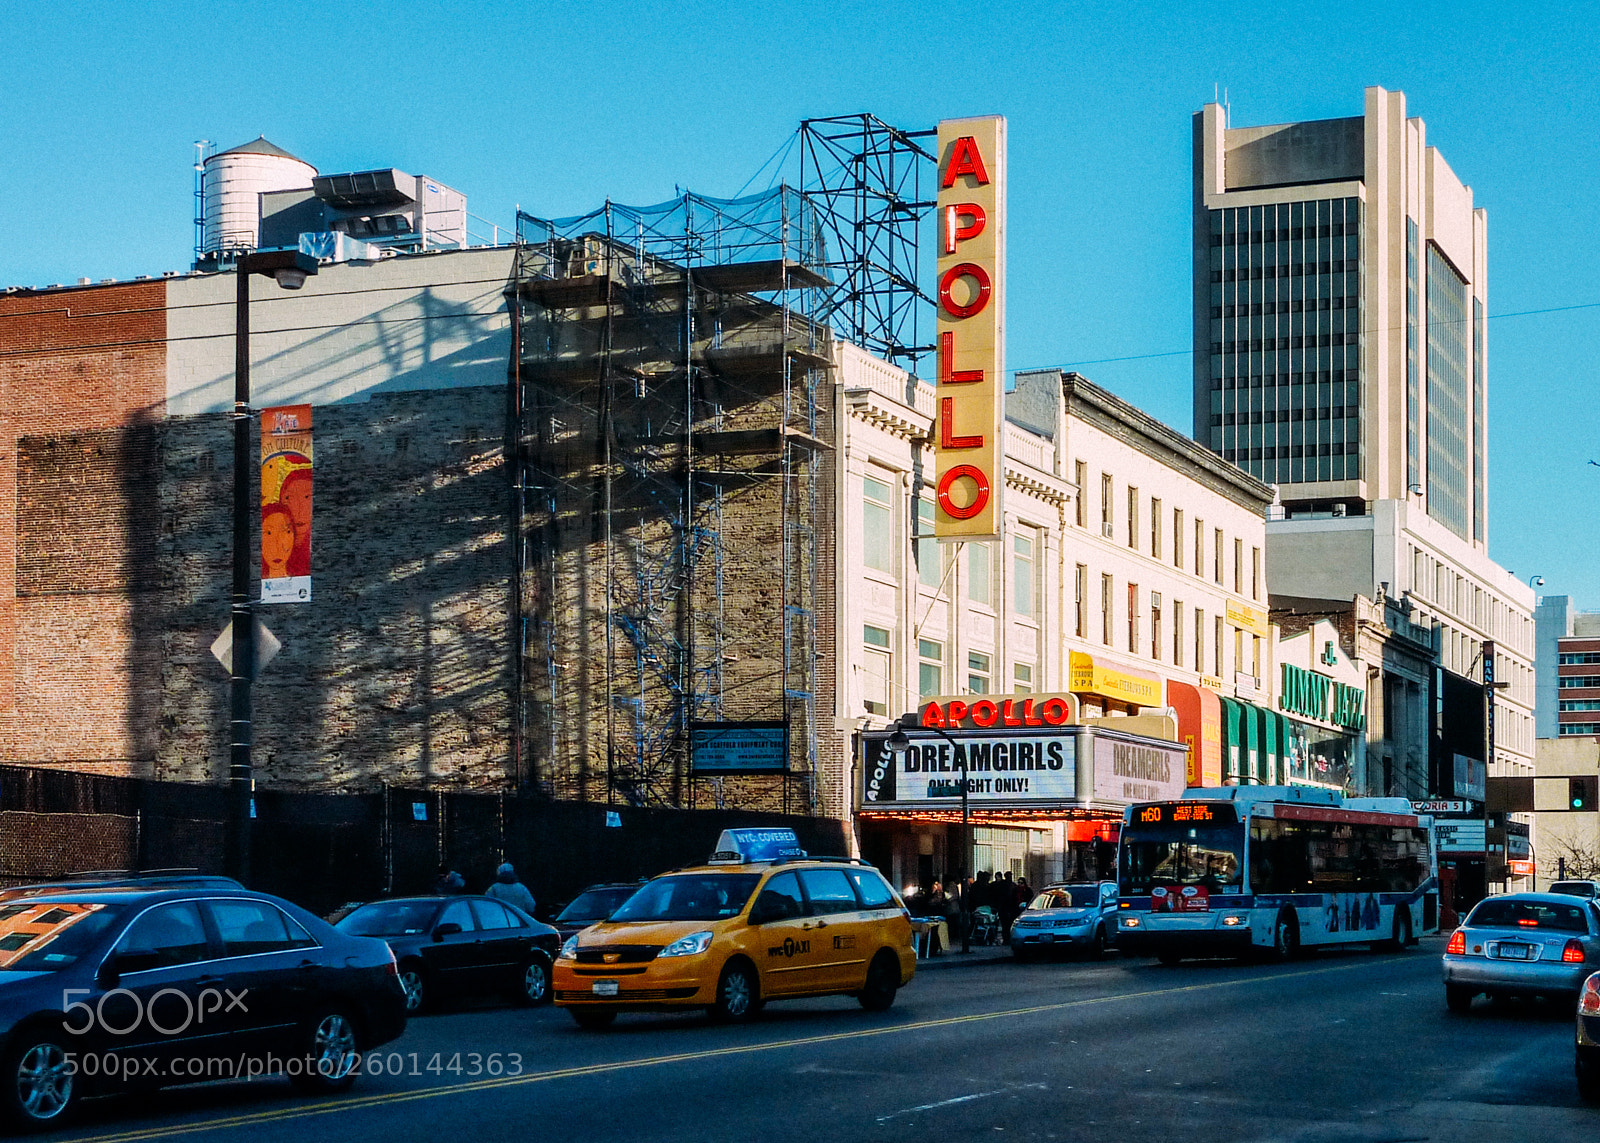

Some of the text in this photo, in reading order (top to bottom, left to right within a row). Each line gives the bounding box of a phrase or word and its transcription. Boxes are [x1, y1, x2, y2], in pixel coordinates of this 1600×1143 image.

[938, 136, 992, 520] APOLLO
[1074, 679, 1093, 687] SPA
[1279, 663, 1332, 721] JIMMY
[1331, 682, 1366, 729] JAZZ
[922, 698, 1069, 728] APOLLO
[905, 742, 1064, 772] DREAMGIRLS
[1113, 743, 1171, 783] DREAMGIRLS
[995, 778, 1028, 793] ONLY!
[1141, 805, 1208, 821] M60 WEST SIDE
[1453, 802, 1459, 810] 5
[1205, 812, 1213, 820] ST
[758, 832, 796, 842] COVERED
